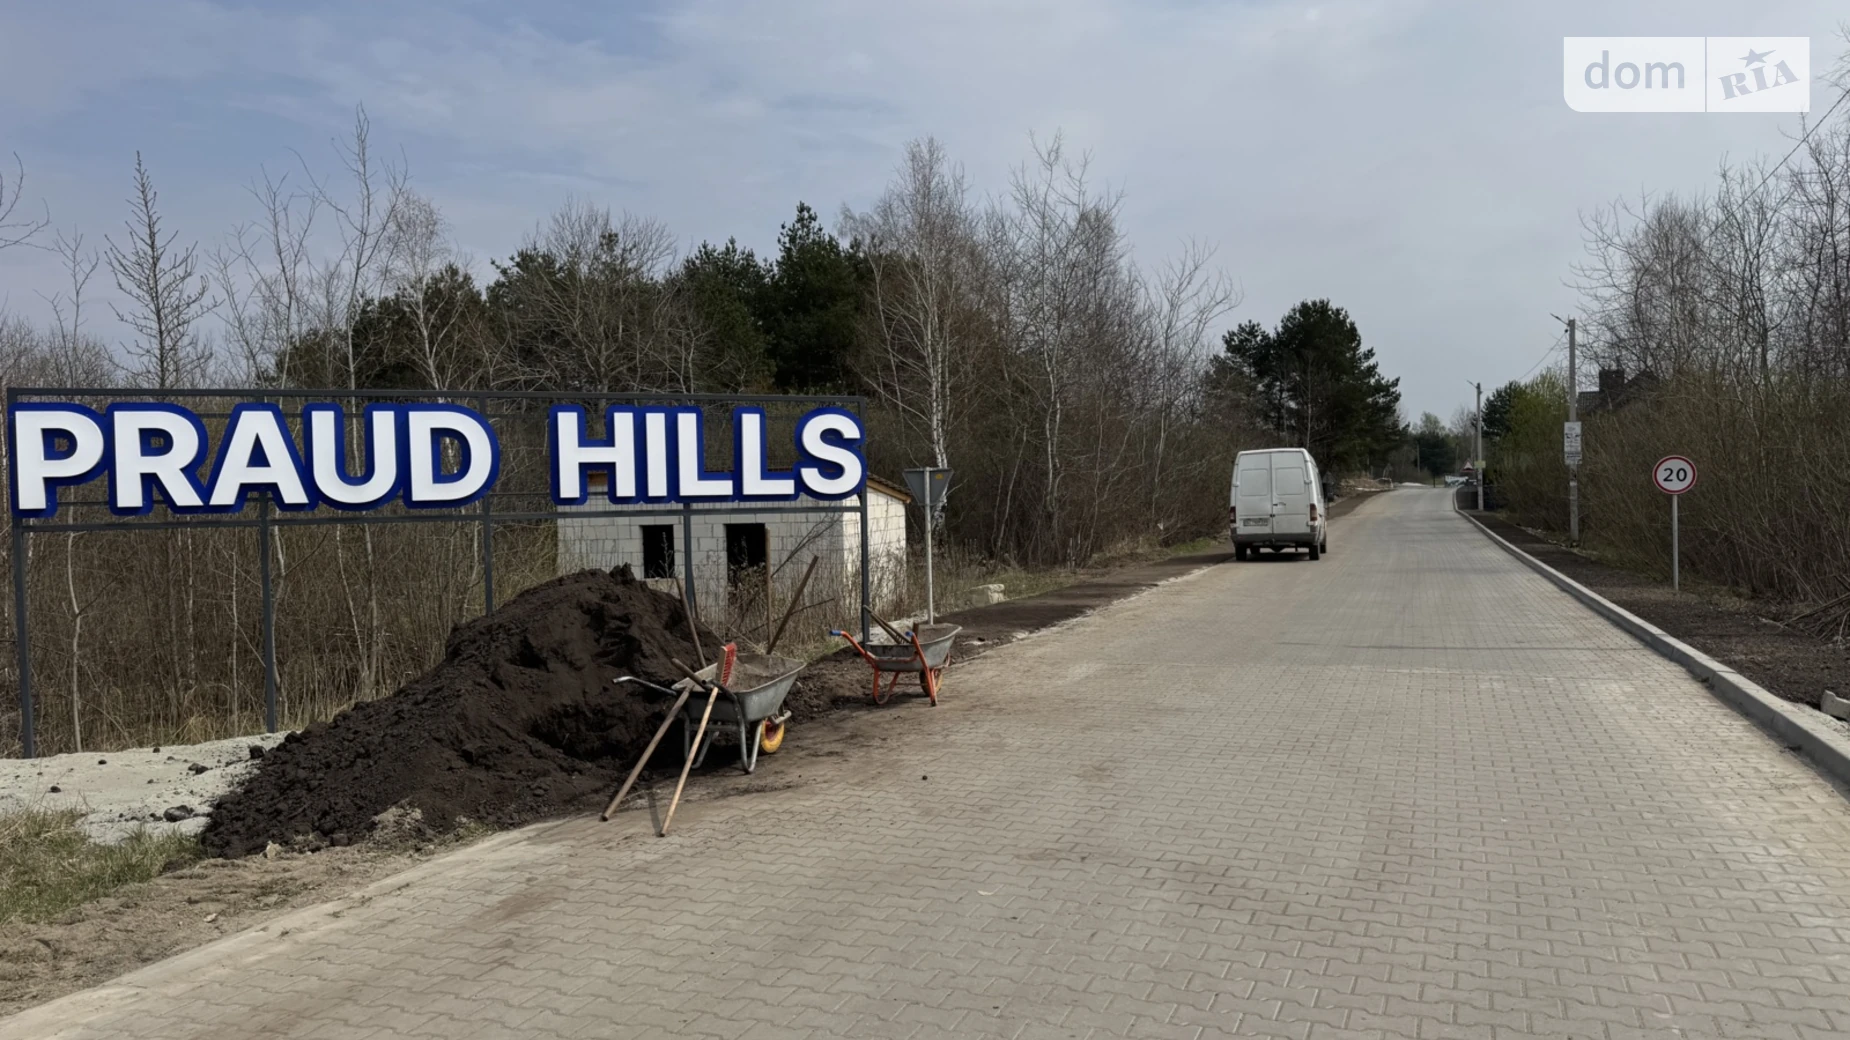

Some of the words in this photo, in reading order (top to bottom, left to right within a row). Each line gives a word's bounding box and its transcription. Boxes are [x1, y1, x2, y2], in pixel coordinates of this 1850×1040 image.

[13, 406, 499, 511] PRAUD
[556, 410, 866, 501] HILLS
[1663, 467, 1687, 482] 20
